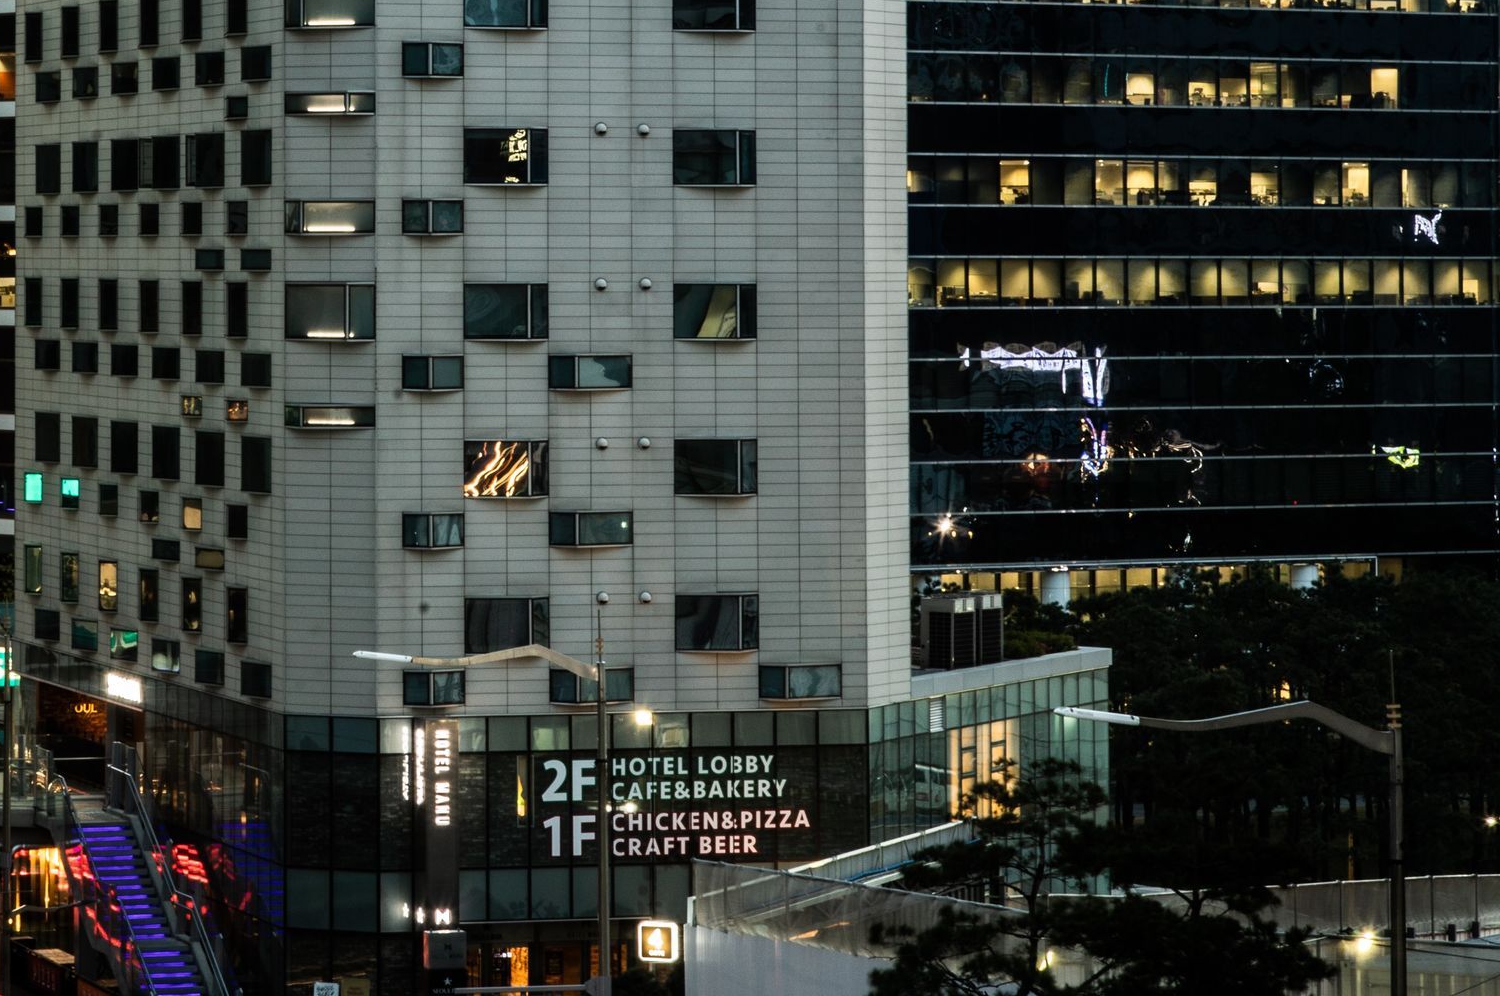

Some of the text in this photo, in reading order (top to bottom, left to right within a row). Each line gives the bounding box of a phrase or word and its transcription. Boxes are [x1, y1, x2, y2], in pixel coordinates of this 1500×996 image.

[612, 755, 774, 776] HOTEL LOBBY
[434, 729, 450, 826] HOTEL MANU
[541, 759, 596, 802] 2F
[612, 779, 787, 800] CAFE&BAKERY
[612, 809, 811, 831] CHICKEN&PIZZA
[543, 815, 596, 857] 1F
[612, 835, 758, 856] CRAFT BEER
